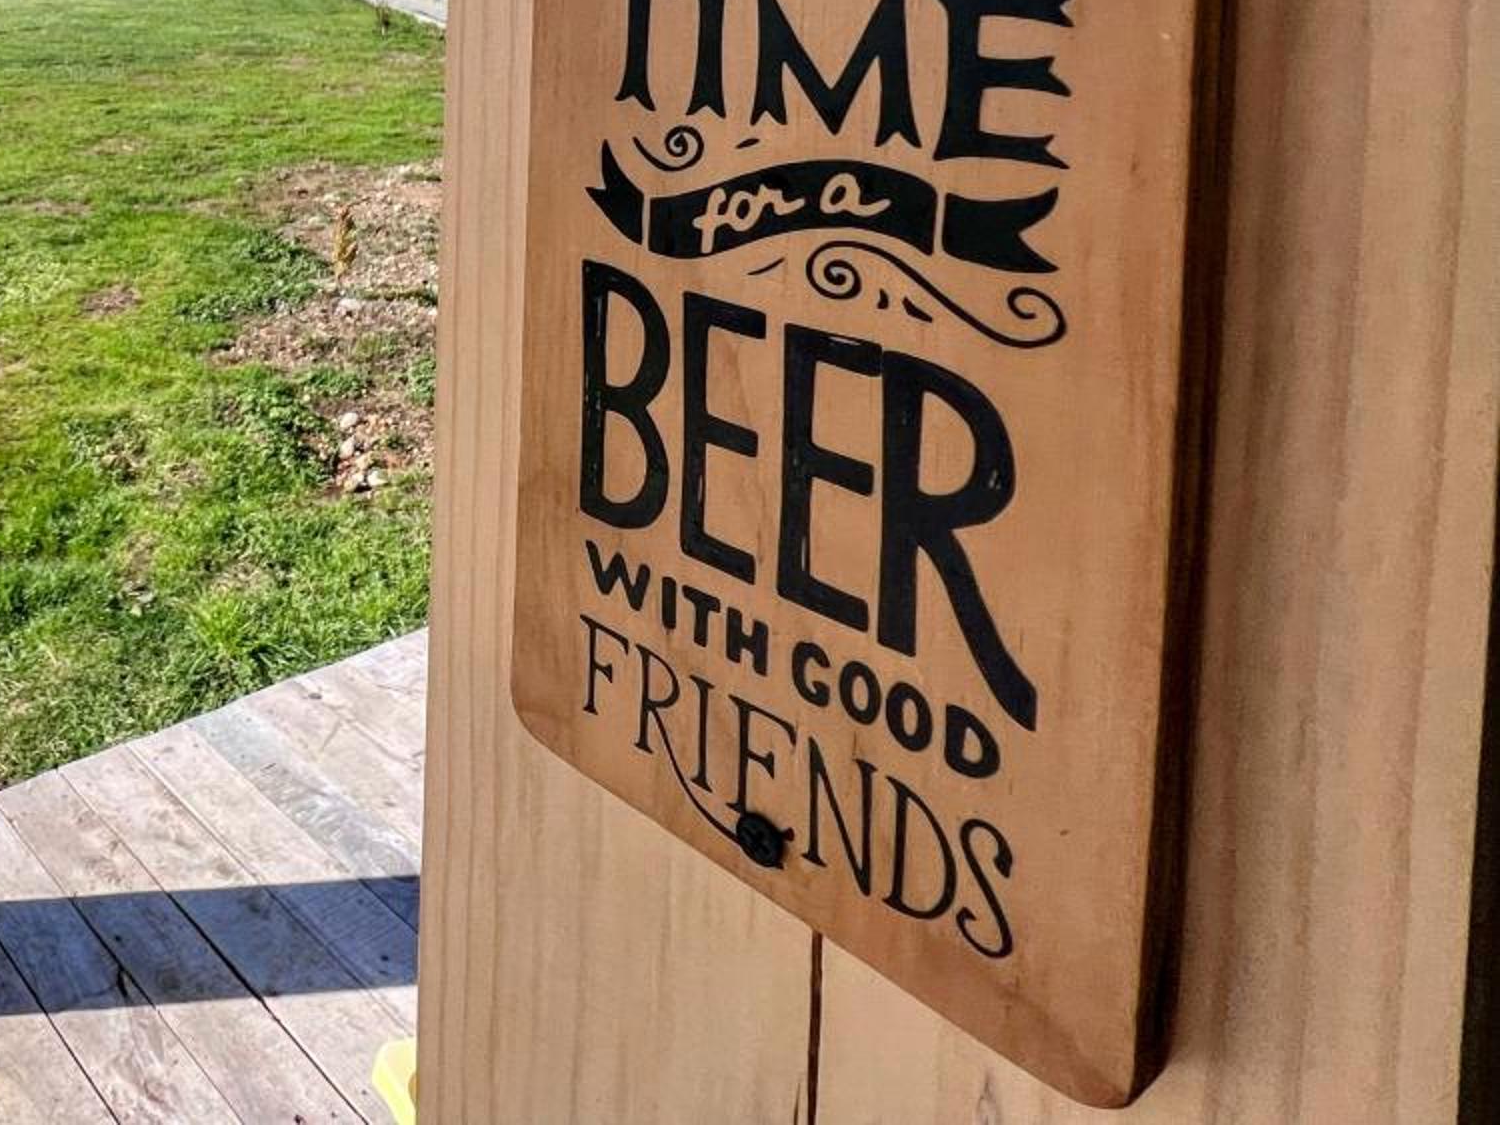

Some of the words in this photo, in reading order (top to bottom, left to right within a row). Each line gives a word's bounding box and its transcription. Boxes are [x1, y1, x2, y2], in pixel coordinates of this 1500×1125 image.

[692, 183, 805, 254] for
[820, 173, 891, 218] a
[580, 259, 1037, 731] BEER
[580, 615, 1013, 959] FRIENDS
[586, 540, 768, 676] WITH
[792, 641, 1000, 778] GOOD
